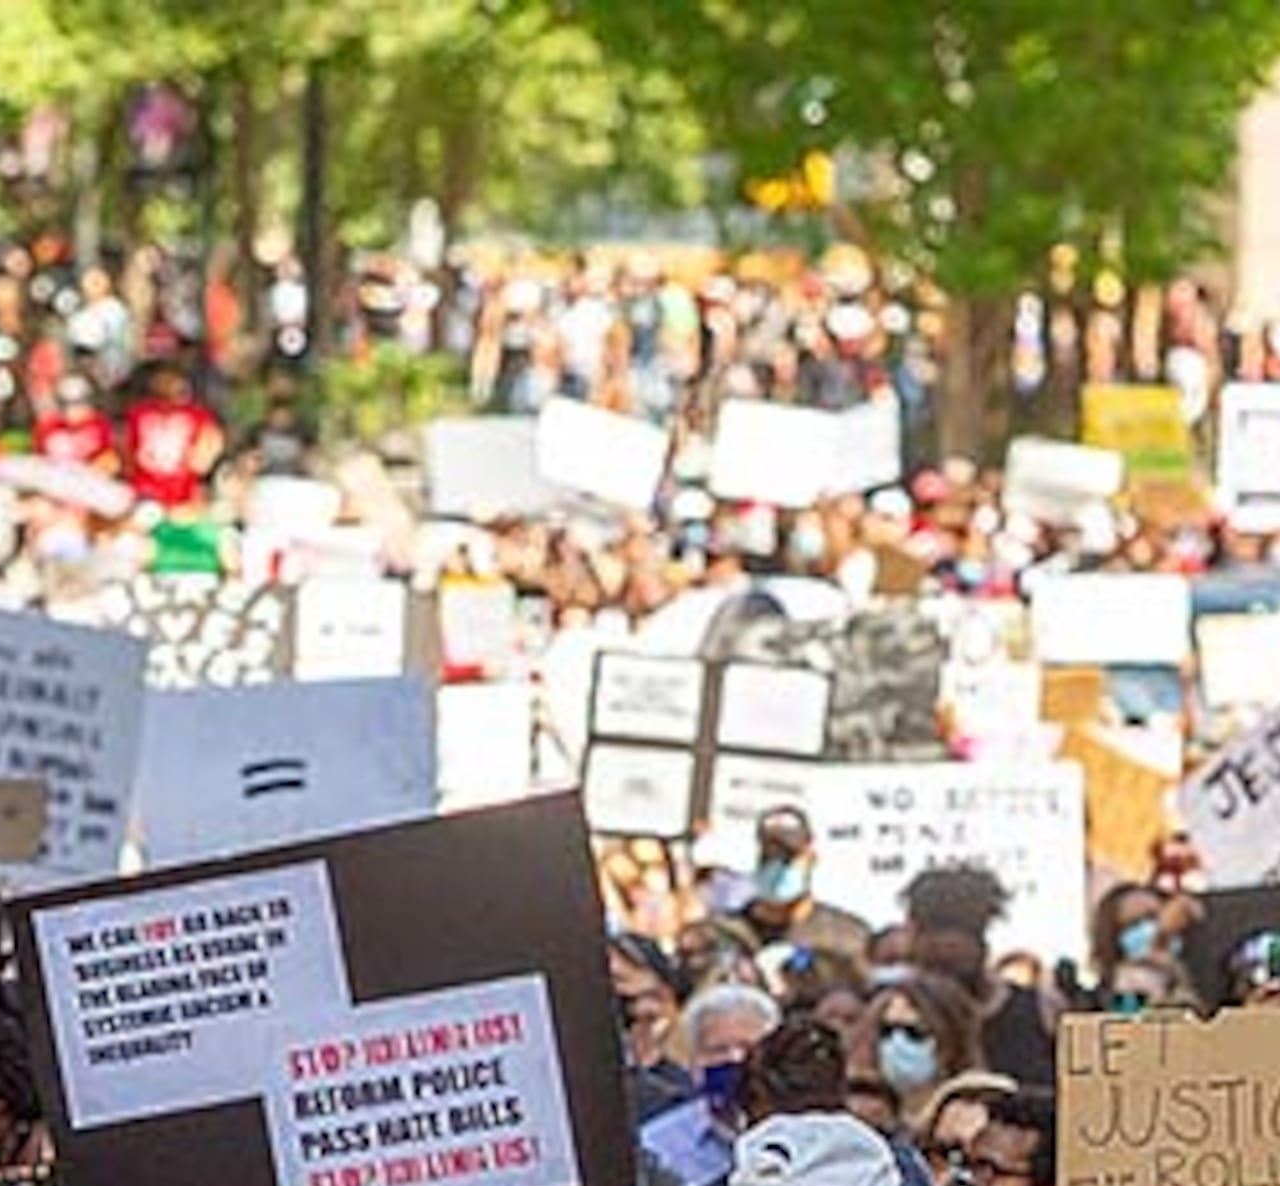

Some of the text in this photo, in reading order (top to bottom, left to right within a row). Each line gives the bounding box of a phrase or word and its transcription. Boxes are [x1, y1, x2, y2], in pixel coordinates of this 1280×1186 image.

[1068, 1018, 1168, 1076] LET
[293, 1056, 509, 1120] REFORM POLICE
[300, 1096, 524, 1161] PASS HATE BILLS
